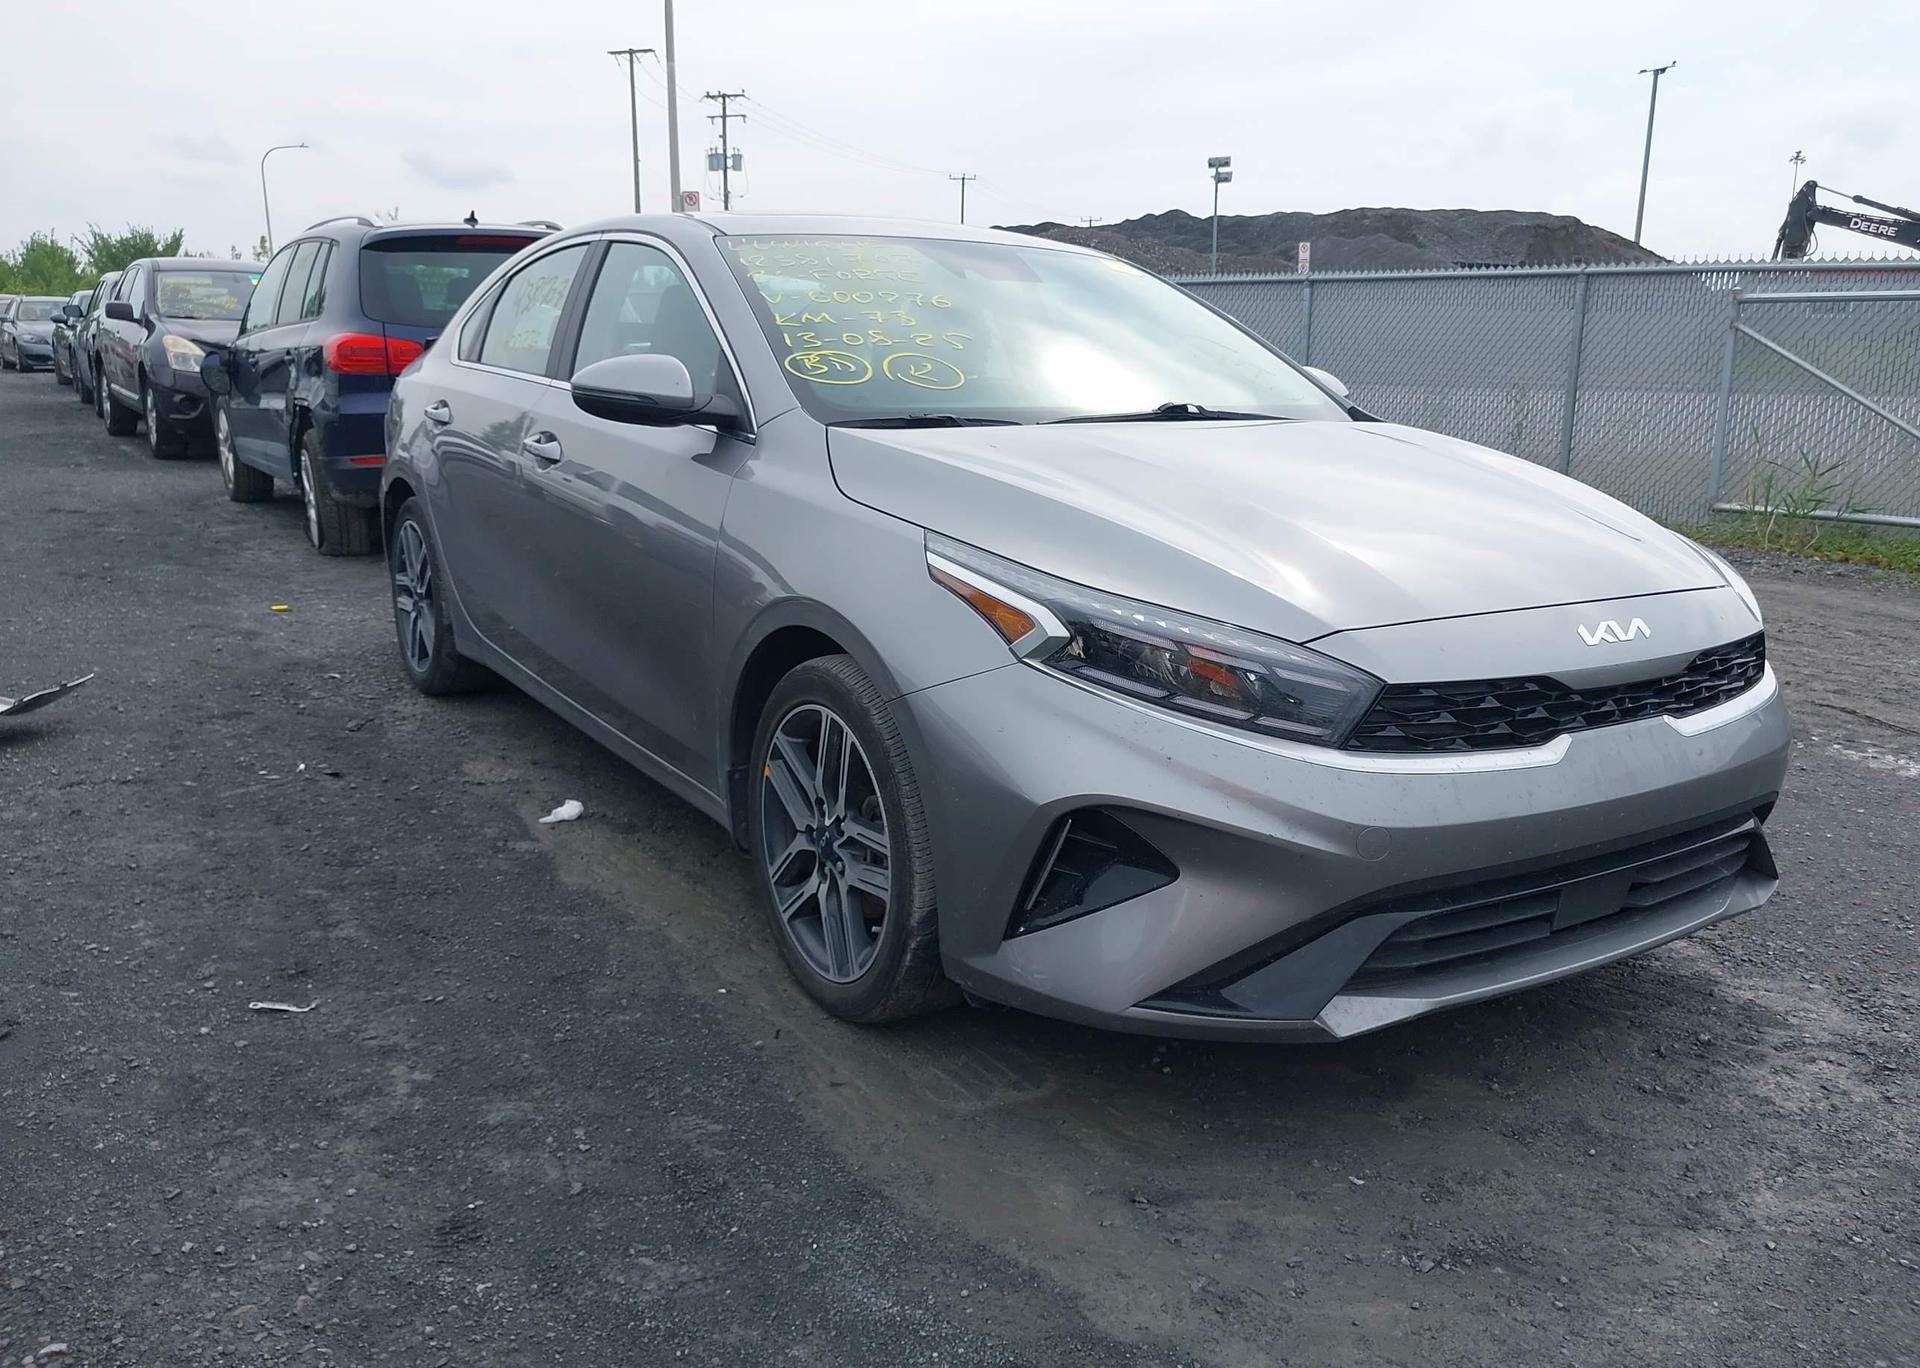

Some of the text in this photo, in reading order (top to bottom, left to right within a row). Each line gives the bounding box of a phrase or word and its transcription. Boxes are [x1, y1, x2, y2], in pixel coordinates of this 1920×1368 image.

[1849, 218, 1898, 236] DEERE
[784, 331, 972, 350] 13-08-25
[1577, 617, 1651, 647] KIA
